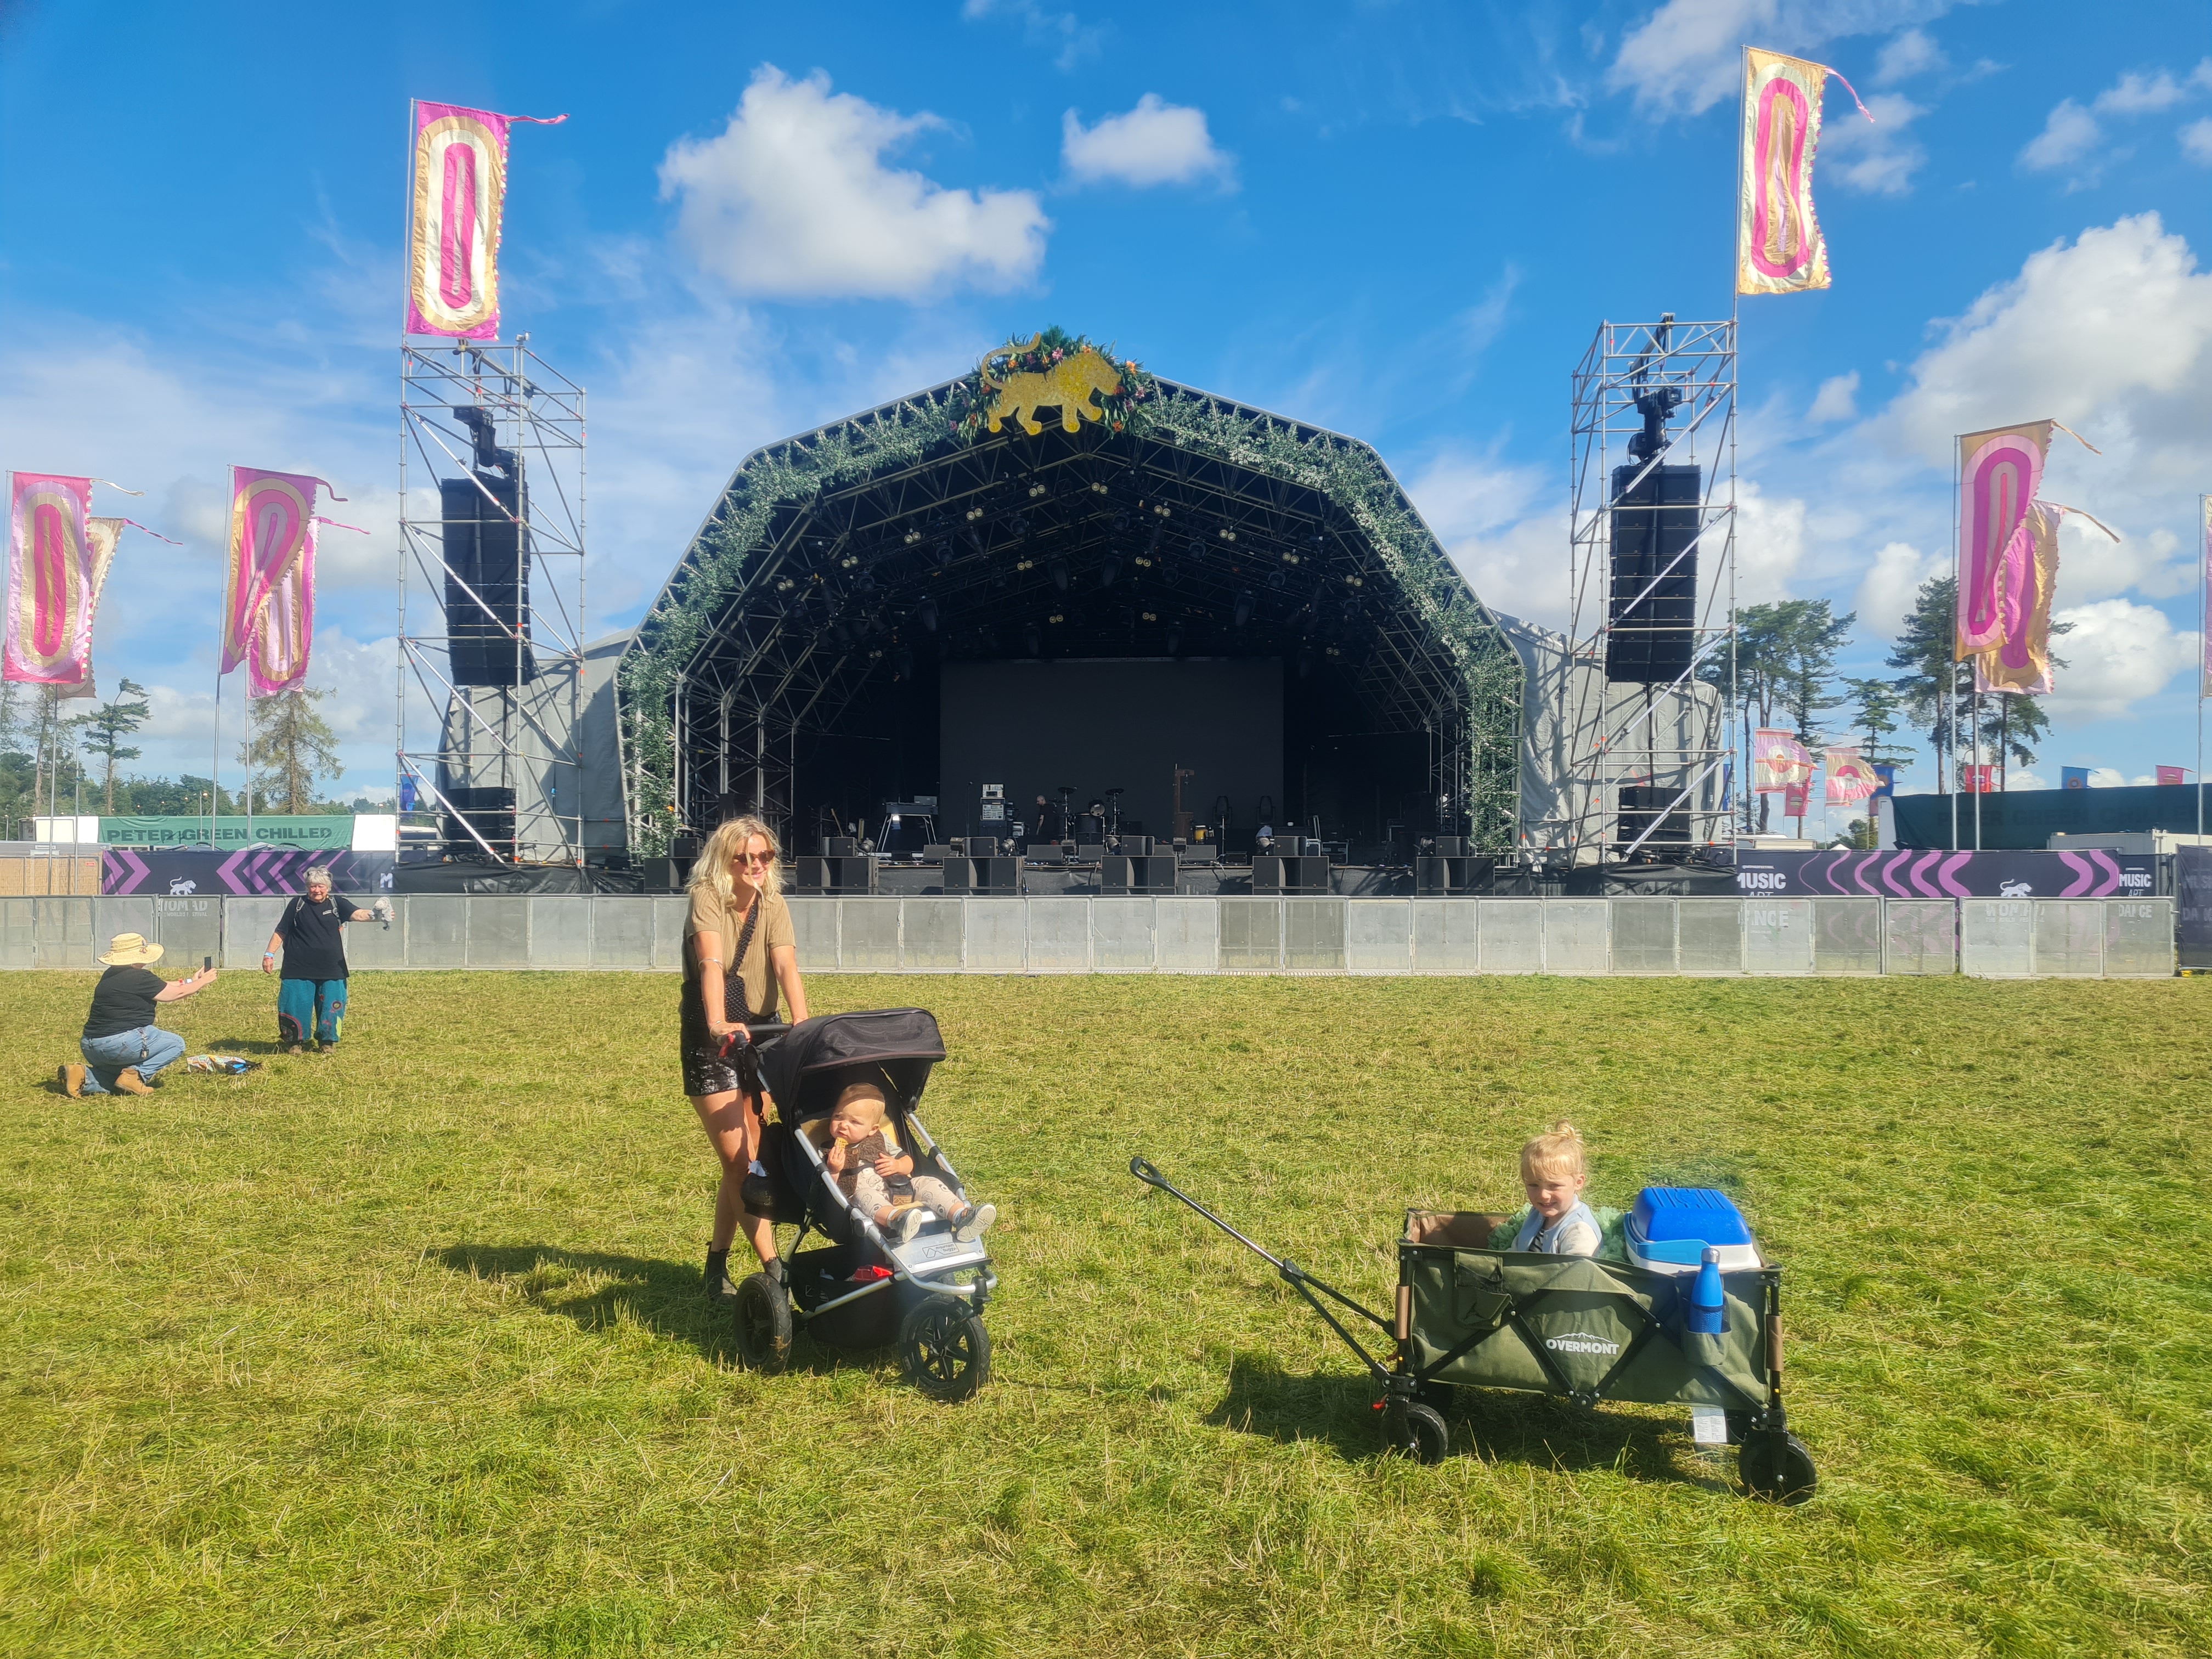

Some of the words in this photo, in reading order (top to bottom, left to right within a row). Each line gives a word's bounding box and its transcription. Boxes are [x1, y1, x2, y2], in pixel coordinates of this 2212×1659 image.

[107, 829, 173, 842] PETER
[182, 828, 247, 840] GREEN
[256, 827, 332, 839] CHILLED
[2119, 873, 2152, 888] MUSIC
[1546, 1339, 1620, 1355] OVERMONT
